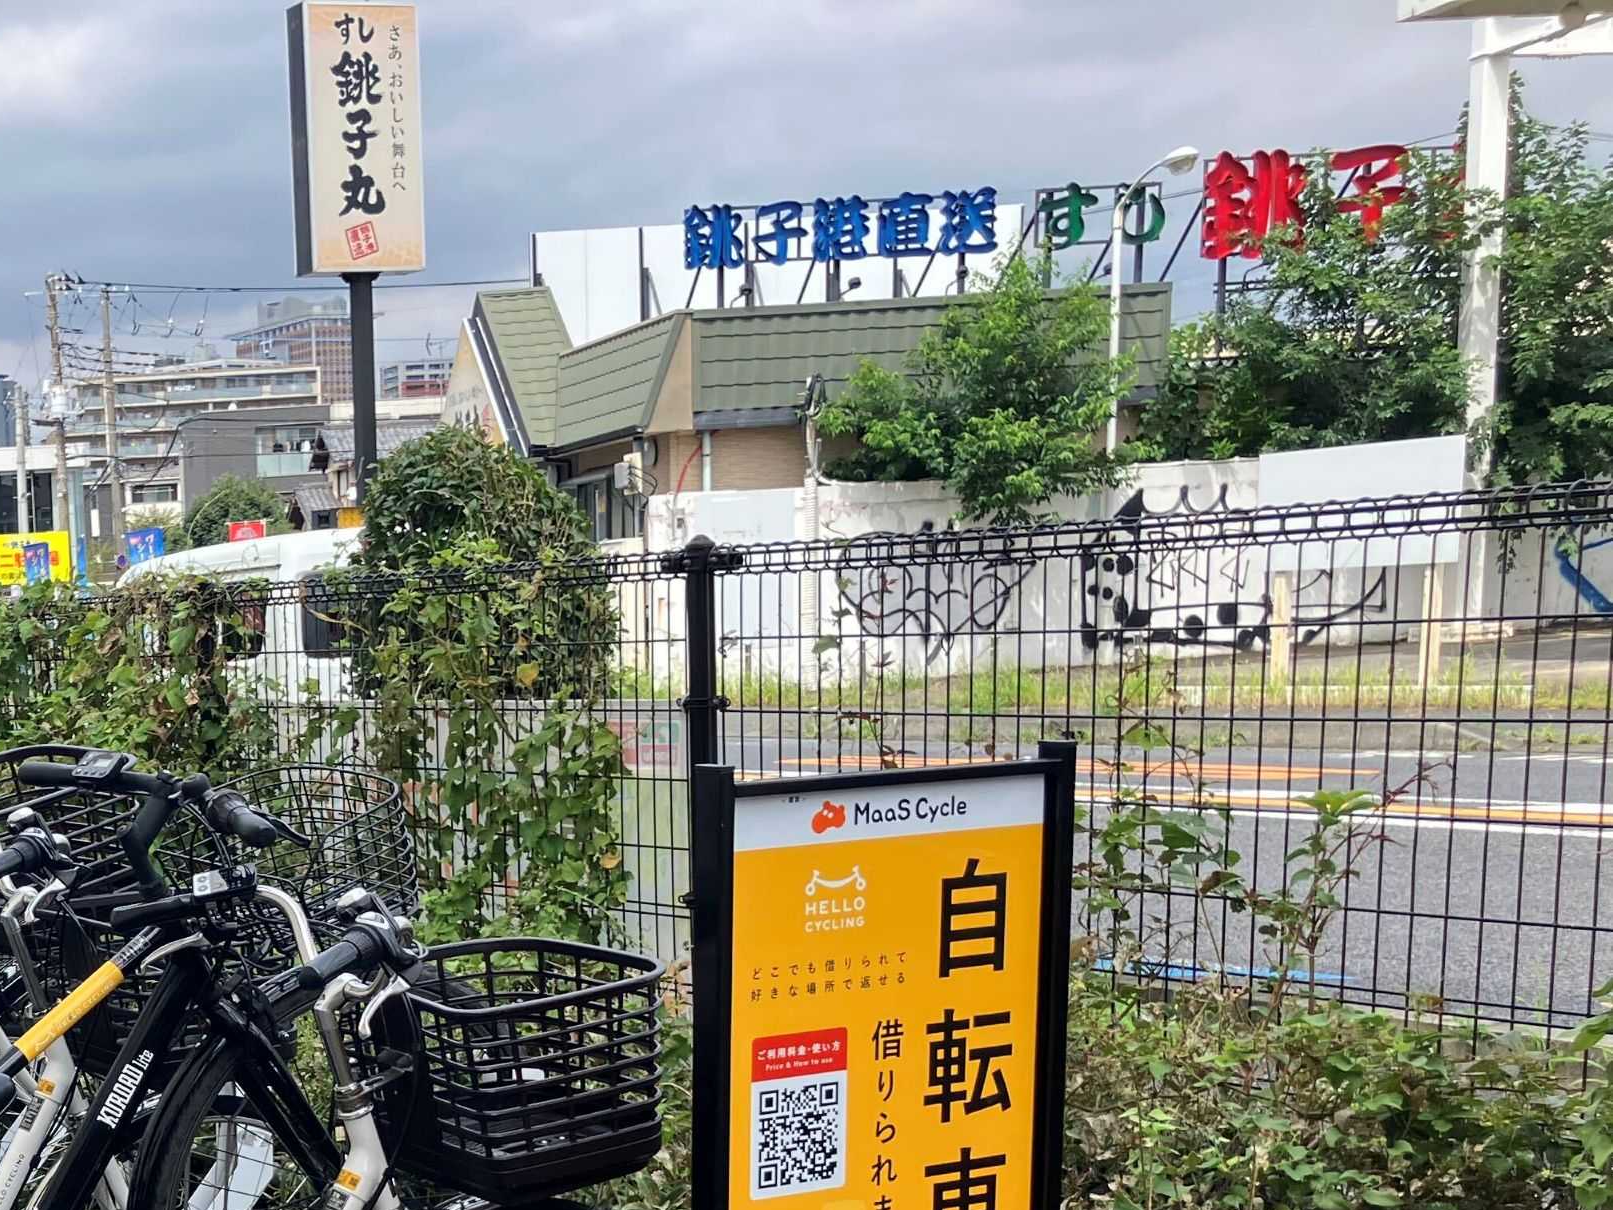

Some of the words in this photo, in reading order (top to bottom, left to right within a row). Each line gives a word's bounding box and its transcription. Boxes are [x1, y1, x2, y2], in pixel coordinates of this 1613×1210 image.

[334, 13, 374, 45] すし
[330, 51, 386, 216] 銚子丸
[684, 186, 998, 270] 銚子港直送
[854, 799, 911, 826] MaaS
[916, 796, 968, 821] Cycle
[805, 896, 866, 917] HELLO
[804, 916, 866, 933] CYCLING
[752, 950, 907, 981] どこでも借りられて
[750, 971, 905, 1002] 好きな場所で返せる
[132, 1049, 154, 1073] lite
